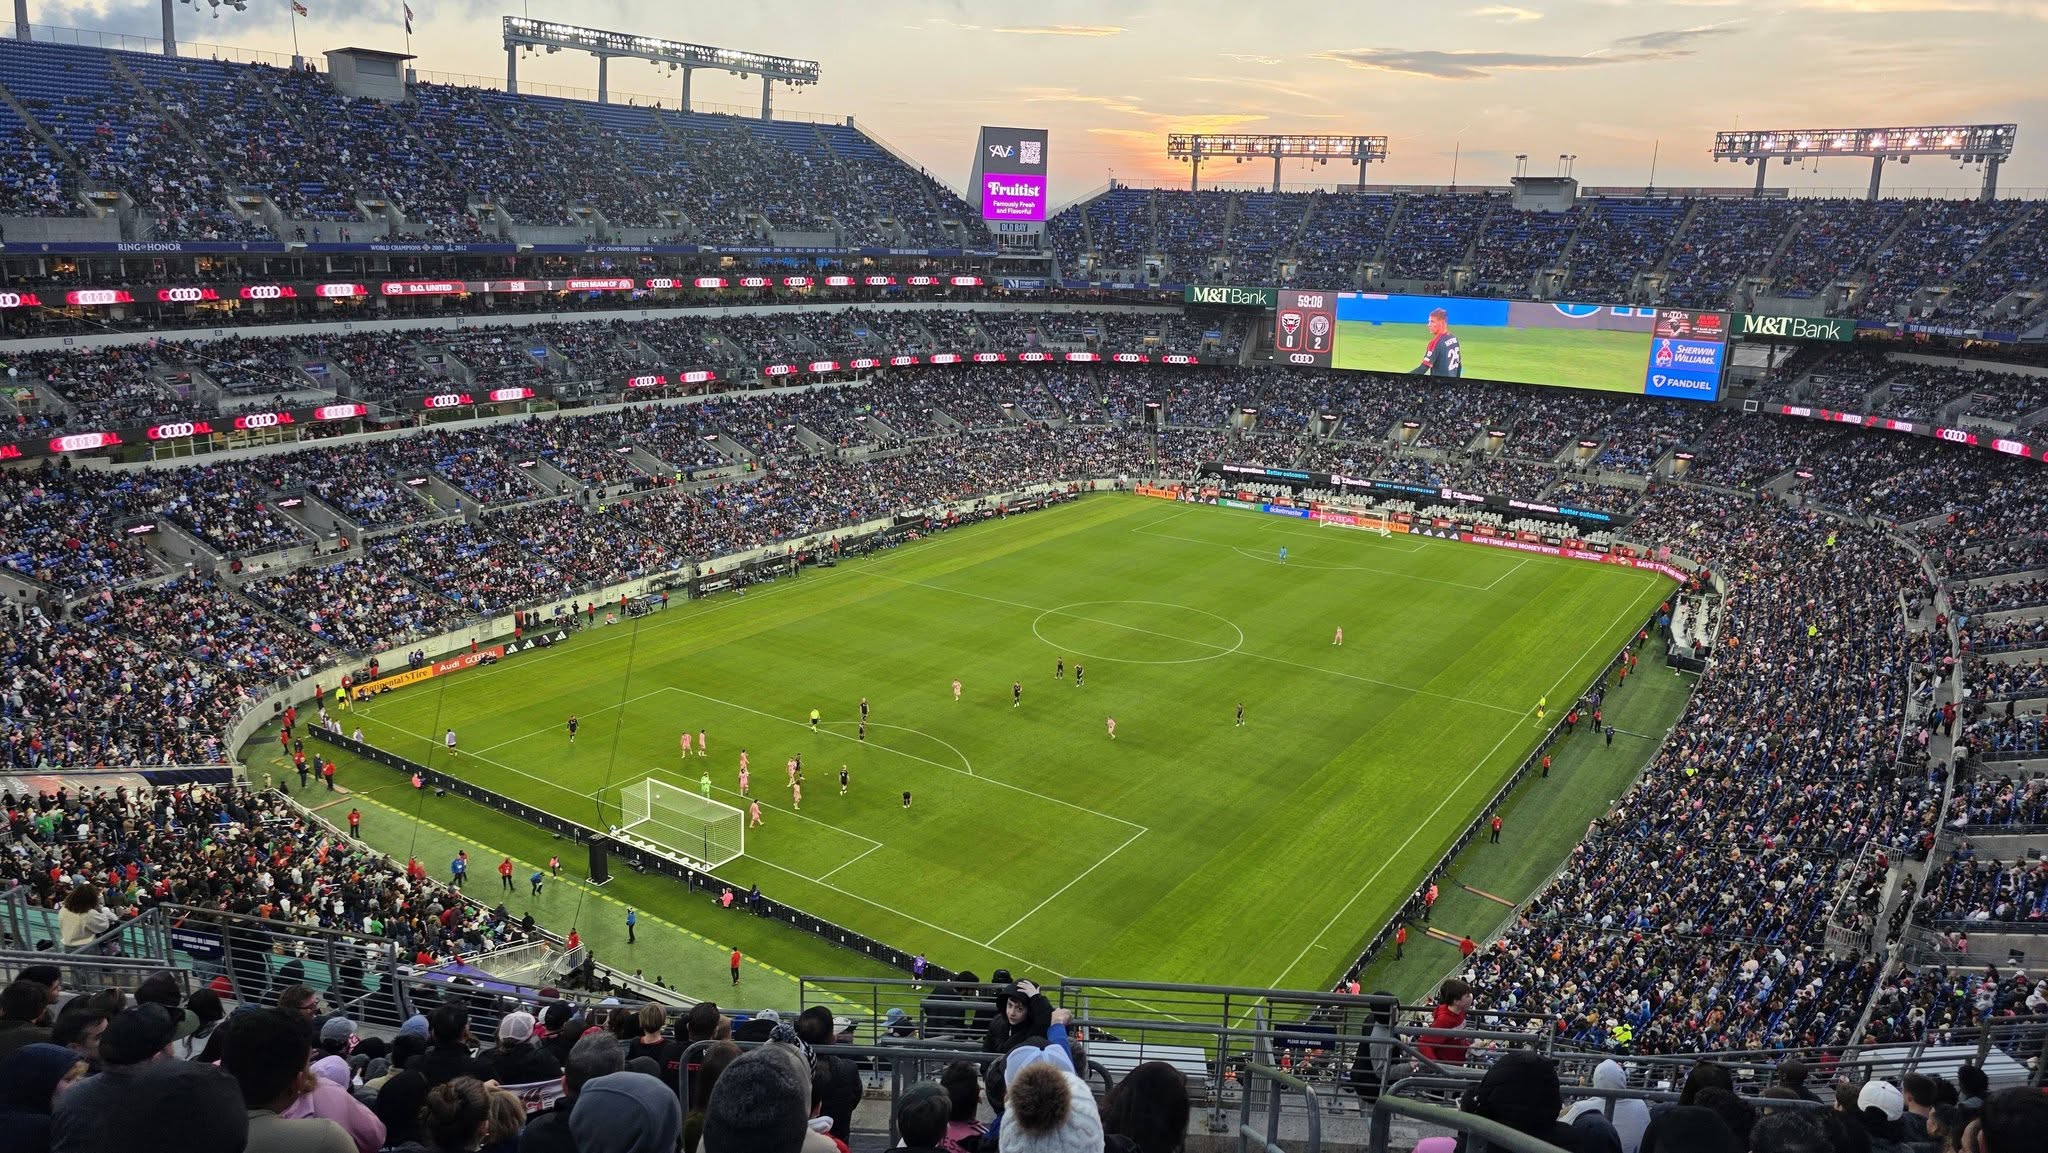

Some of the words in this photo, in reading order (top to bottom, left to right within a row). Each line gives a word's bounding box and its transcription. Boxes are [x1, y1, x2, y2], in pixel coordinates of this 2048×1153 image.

[988, 181, 1040, 197] Fruitist
[993, 201, 1018, 209] Famously
[1001, 223, 1014, 231] OLD
[1015, 223, 1027, 232] BAY
[118, 243, 141, 251] RING
[147, 243, 182, 251] HONOR
[1193, 286, 1232, 303] M&T
[1231, 290, 1268, 306] Bank
[1297, 294, 1324, 308] 59:08
[1742, 314, 1793, 336] M&T
[1792, 318, 1842, 340] Bank
[1286, 335, 1293, 348] 0
[1313, 337, 1322, 350] 2
[1676, 344, 1716, 357] SHERWIN
[1667, 378, 1712, 391] FANDUEL
[1266, 469, 1282, 477] Better
[1270, 507, 1304, 517] ticketmaster
[1509, 500, 1528, 508] Better
[1559, 507, 1579, 516] Better
[1472, 536, 1488, 544] SAVE
[1488, 538, 1504, 546] TIME
[1518, 542, 1542, 551] MONEY
[1542, 546, 1560, 554] WITH
[1636, 561, 1654, 569] SAVE
[439, 660, 460, 672] Audi
[407, 670, 428, 681] Tire
